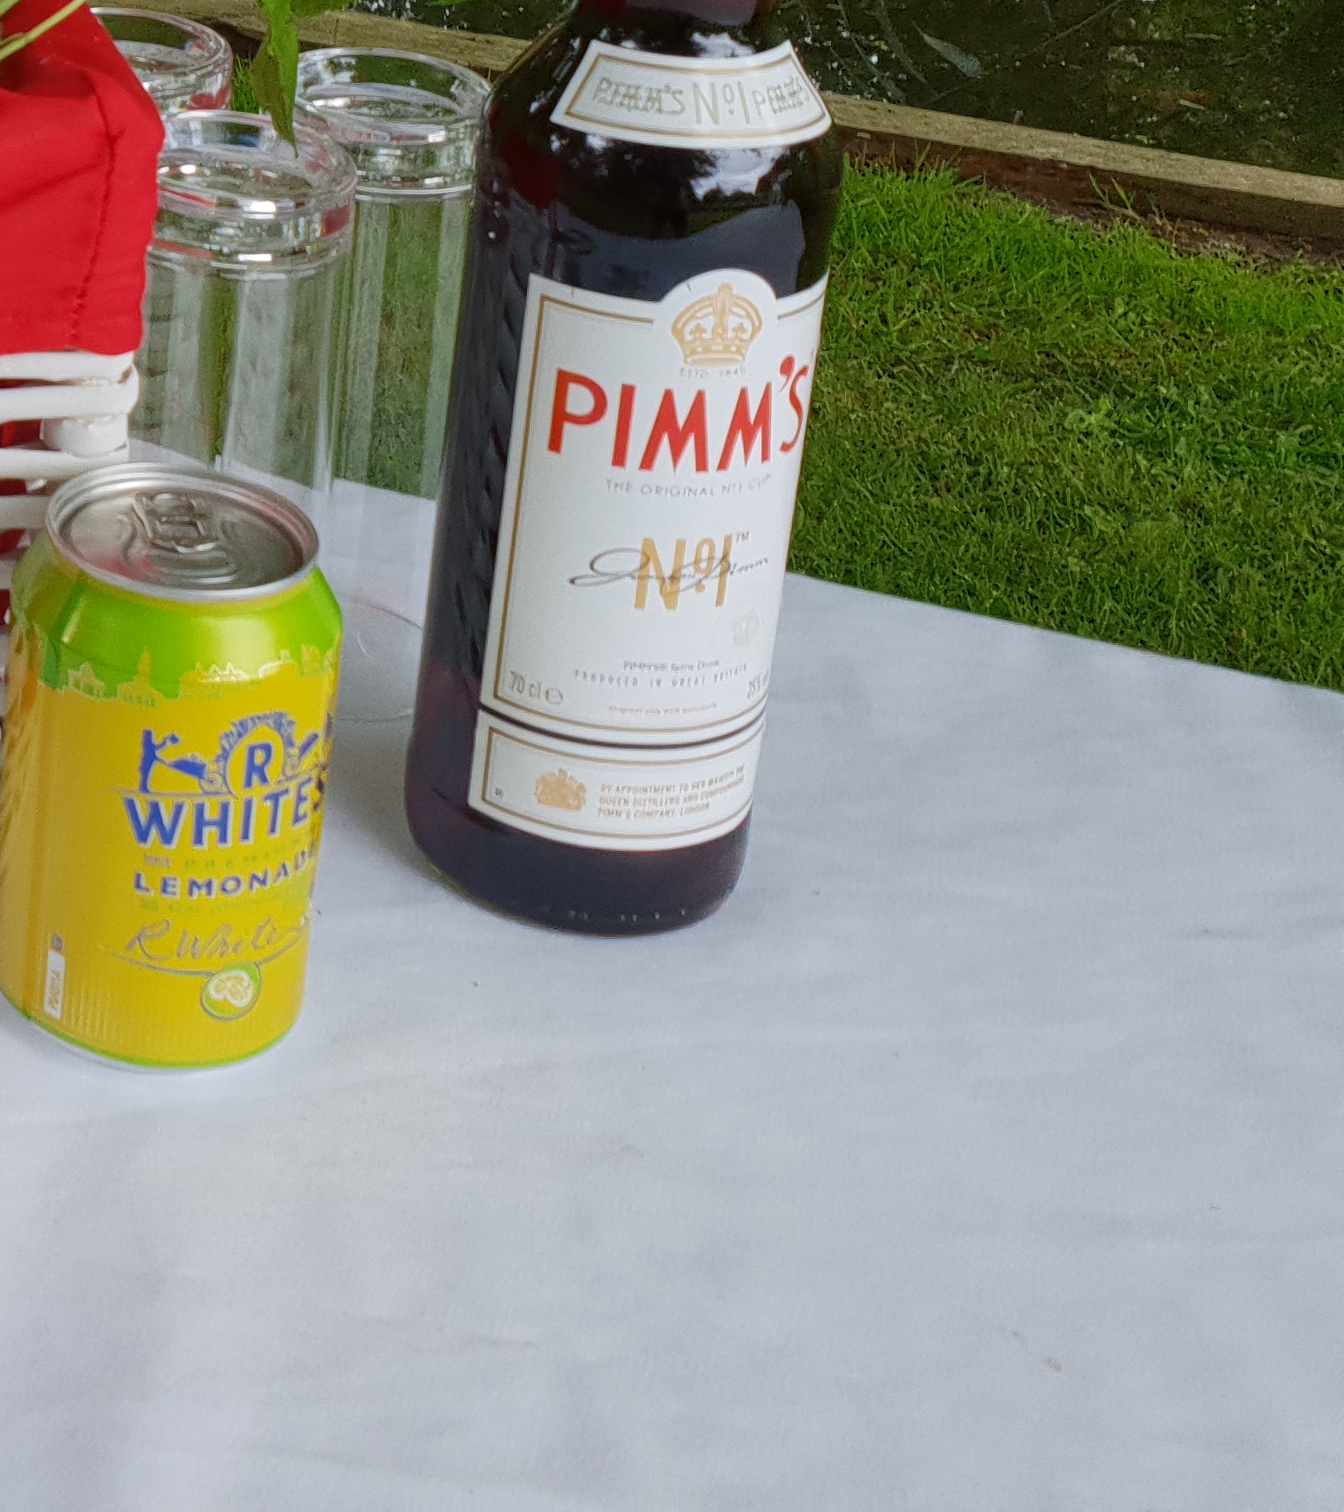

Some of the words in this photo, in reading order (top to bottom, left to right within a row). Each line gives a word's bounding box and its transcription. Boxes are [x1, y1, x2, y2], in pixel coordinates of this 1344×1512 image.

[547, 354, 810, 475] PIMM'S
[640, 482, 715, 497] ORIGINAL
[243, 741, 273, 791] R
